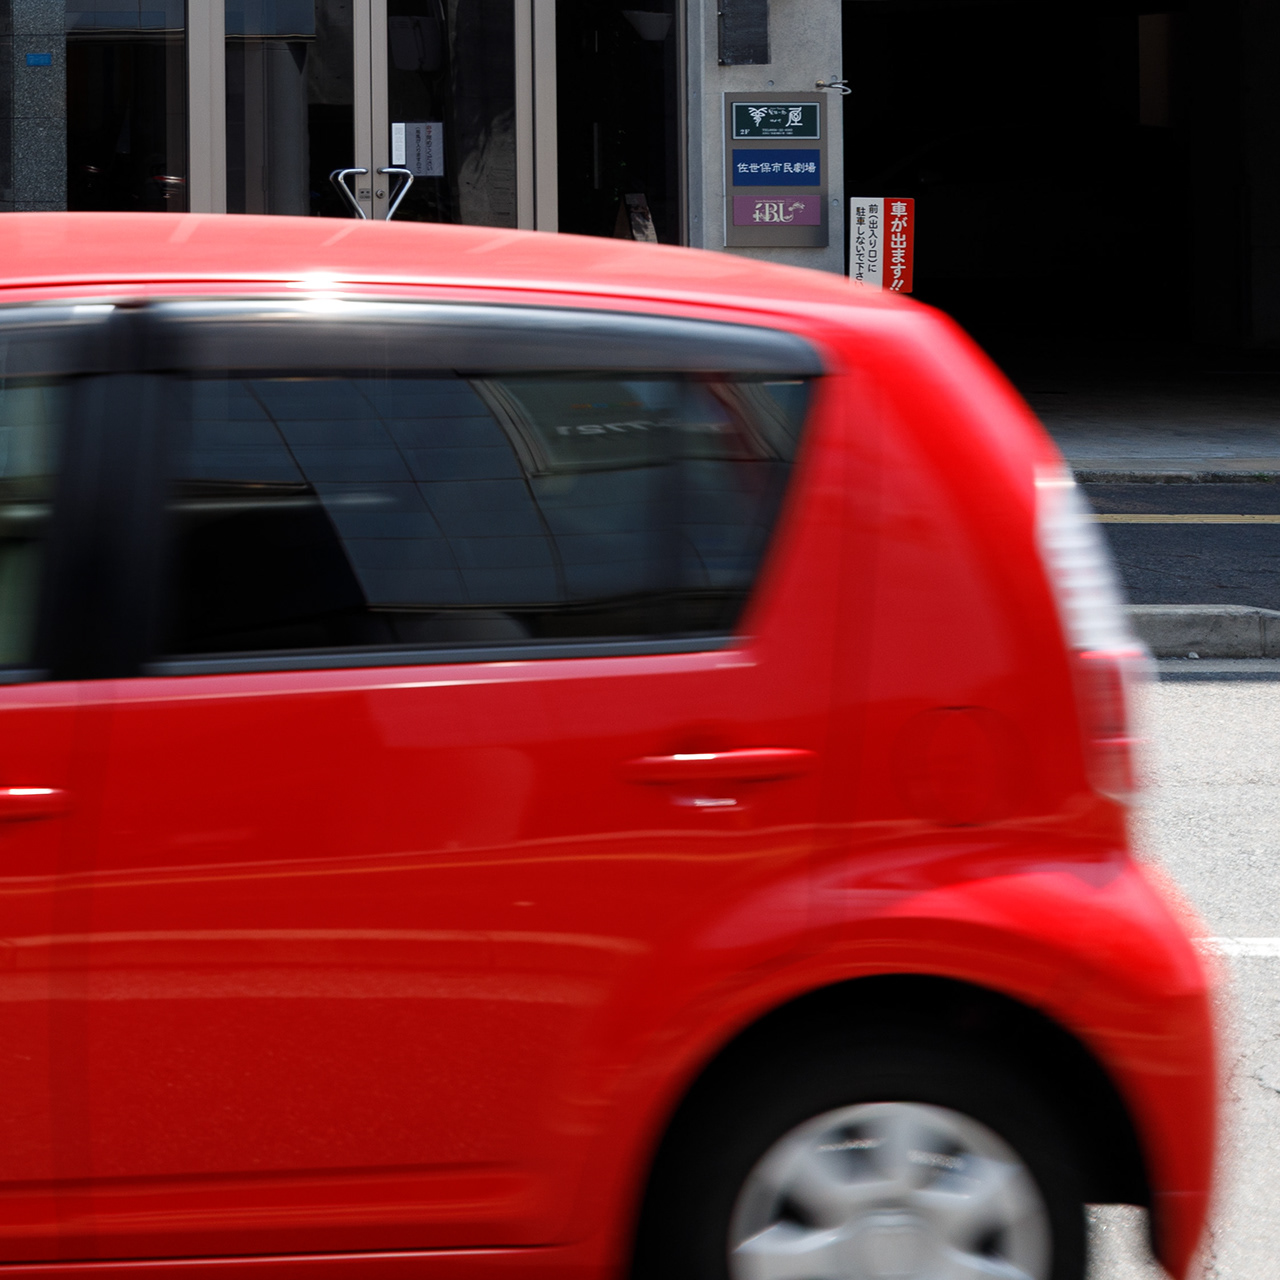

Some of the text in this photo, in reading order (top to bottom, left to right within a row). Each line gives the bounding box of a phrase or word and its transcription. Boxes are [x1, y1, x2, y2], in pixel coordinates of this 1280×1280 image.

[737, 162, 817, 173] 佐世保市民劇場
